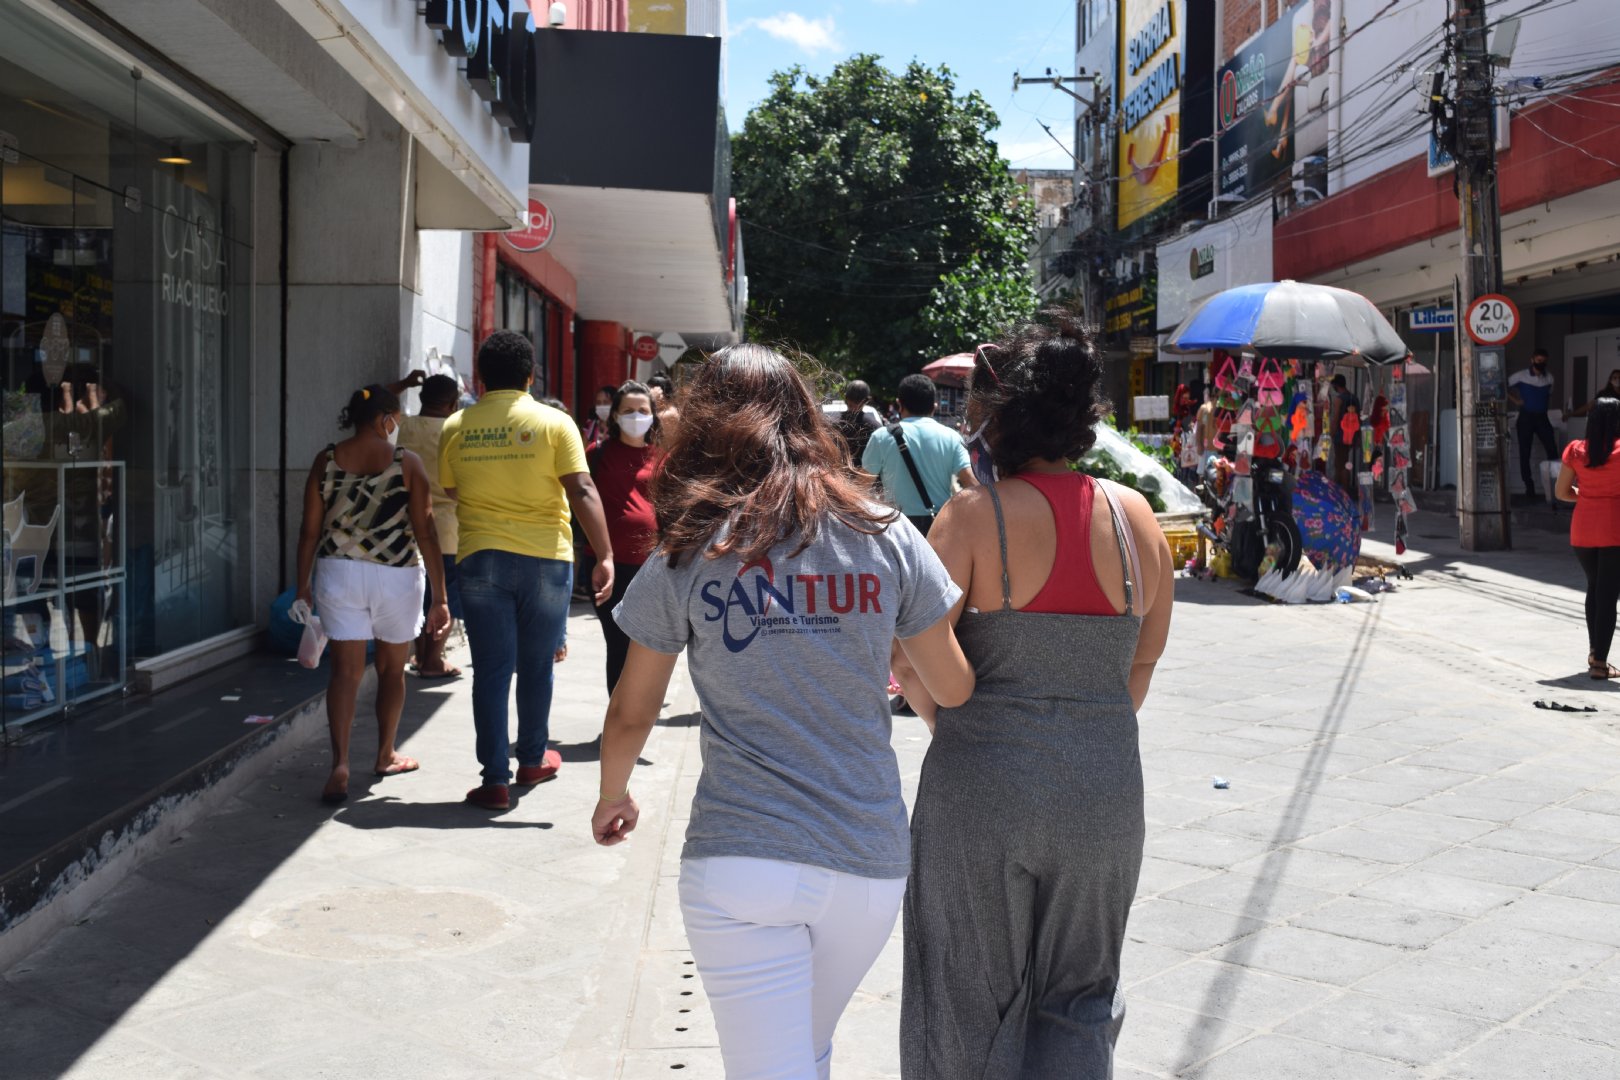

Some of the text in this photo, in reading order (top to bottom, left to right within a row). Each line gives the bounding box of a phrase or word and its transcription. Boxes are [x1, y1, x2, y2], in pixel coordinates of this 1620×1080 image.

[1128, 1, 1174, 76] SORRIA
[1123, 53, 1179, 134] TERESINA
[162, 272, 228, 316] RIACHUELO
[1480, 302, 1503, 321] 20
[1476, 323, 1508, 334] Km/h
[464, 434, 480, 442] DOM
[701, 573, 882, 653] SANTUR
[750, 615, 839, 628] Viagens e Turismo
